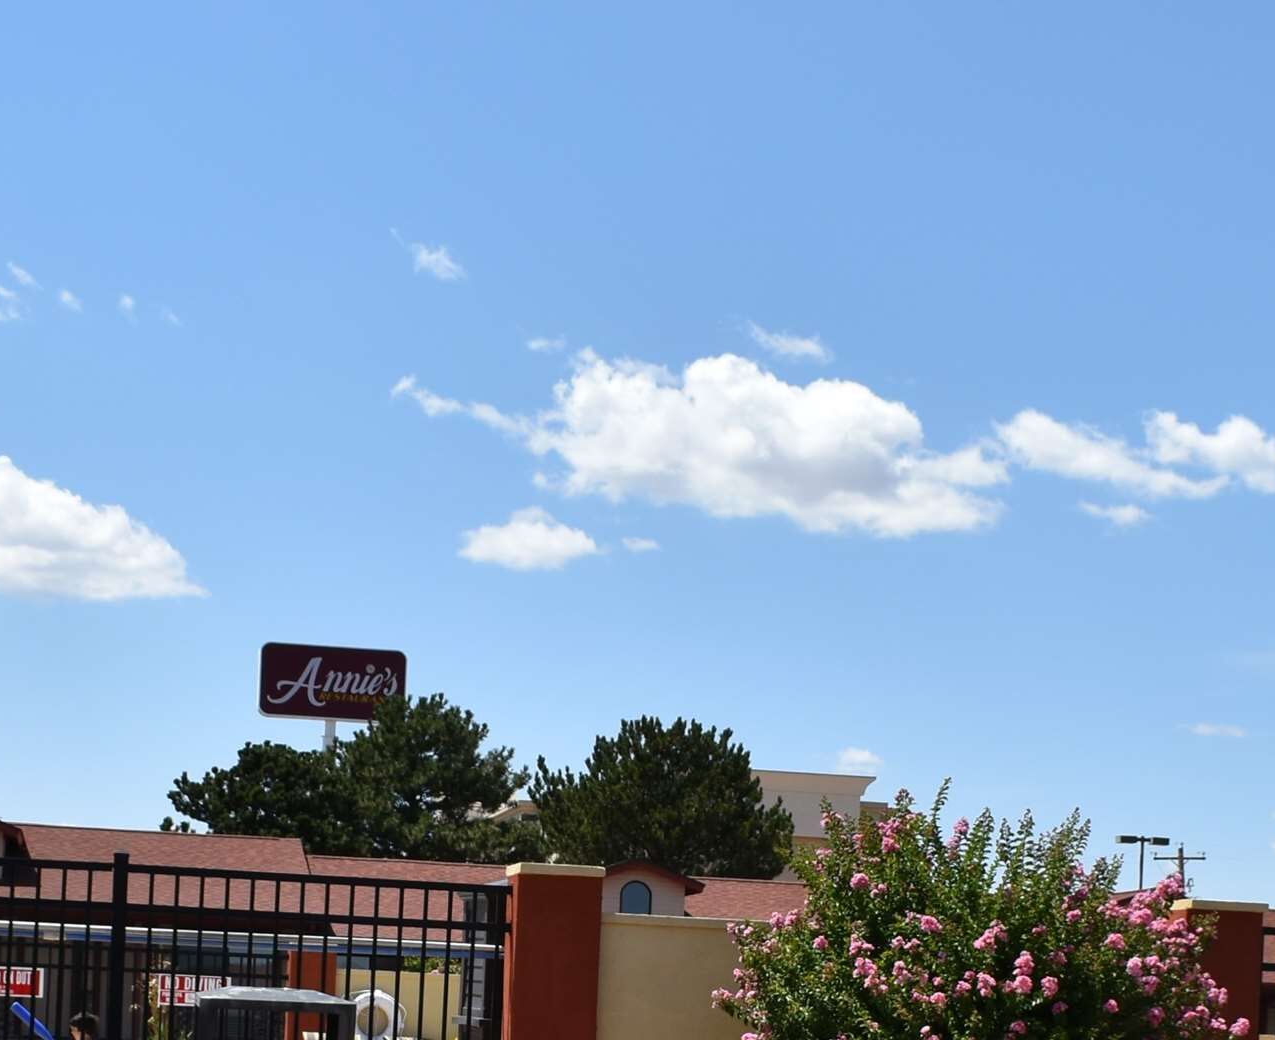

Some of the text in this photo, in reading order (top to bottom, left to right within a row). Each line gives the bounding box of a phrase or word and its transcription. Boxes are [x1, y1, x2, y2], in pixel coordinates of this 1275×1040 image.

[267, 657, 398, 706] Annie's
[319, 692, 385, 704] RESTAURAN
[16, 971, 32, 985] DUT
